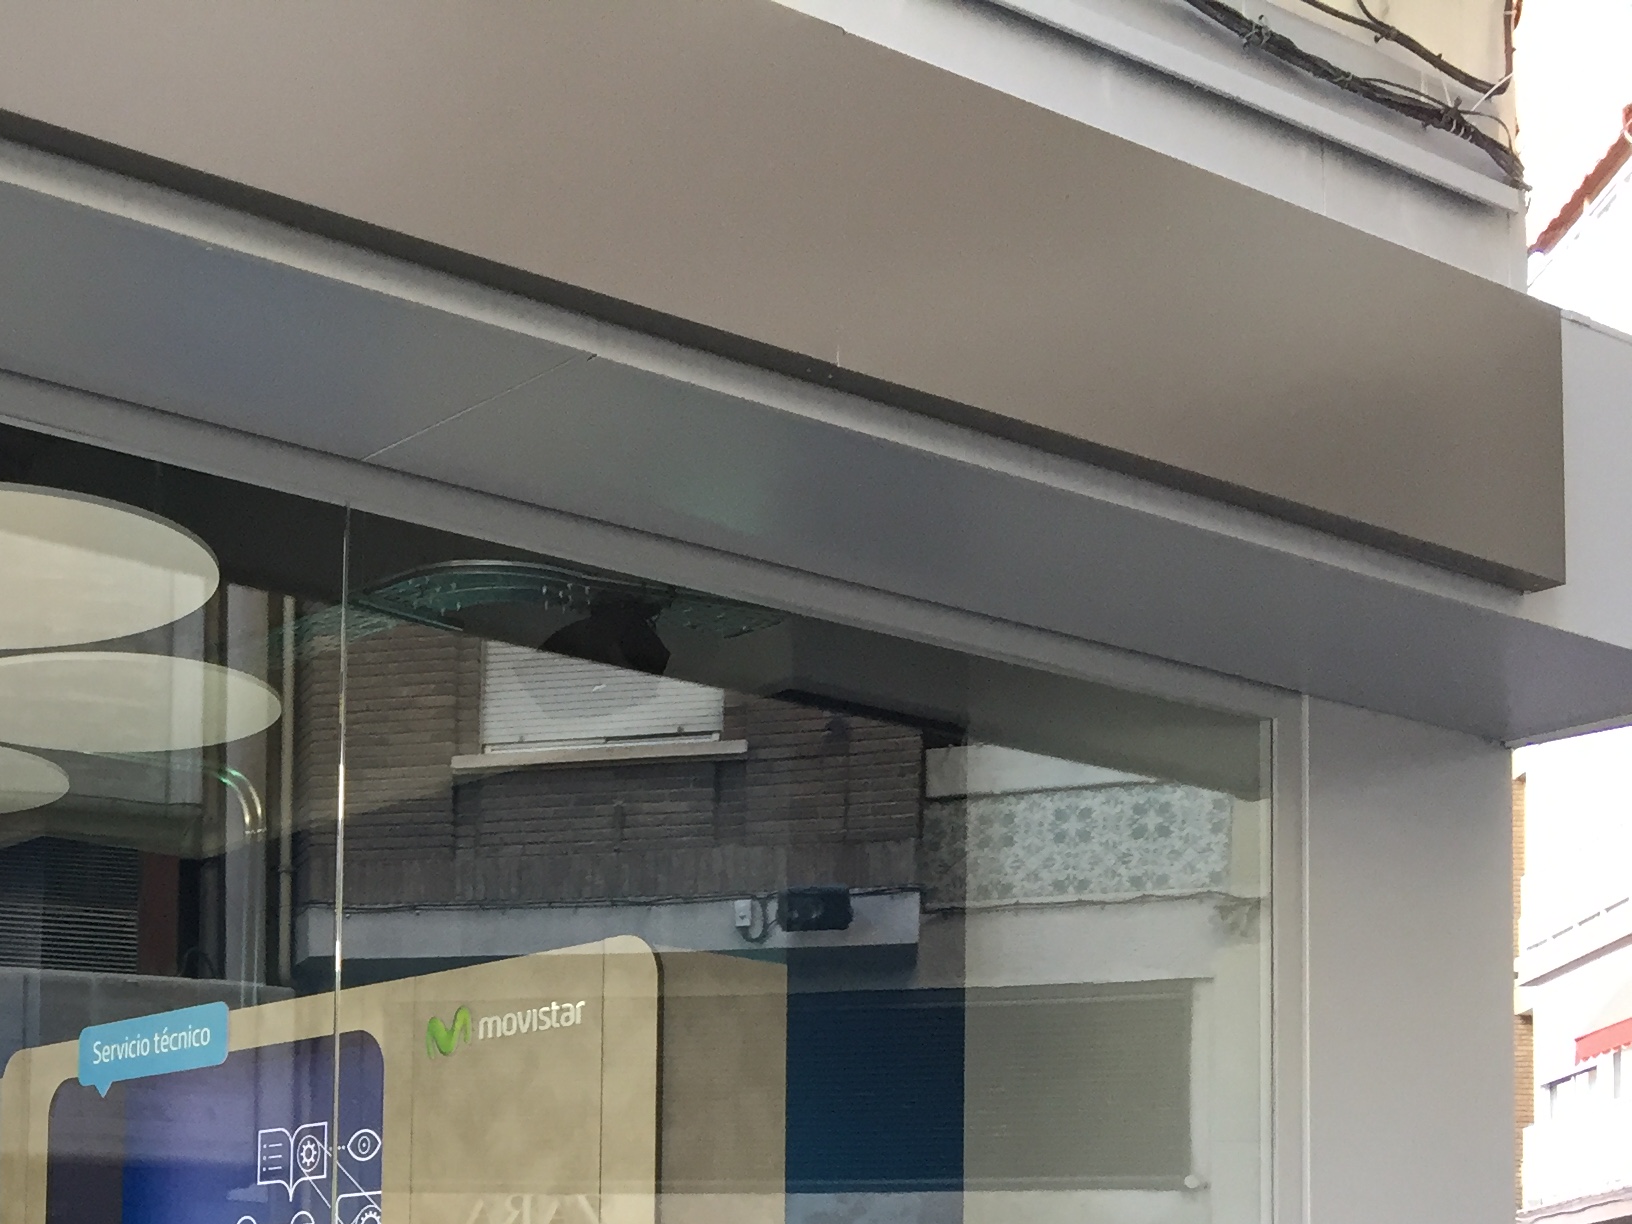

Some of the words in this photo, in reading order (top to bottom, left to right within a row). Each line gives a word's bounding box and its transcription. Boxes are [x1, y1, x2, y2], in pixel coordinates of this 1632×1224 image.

[478, 1000, 586, 1040] movistar
[92, 1033, 150, 1065] Servicio
[153, 1024, 211, 1054] técnico
